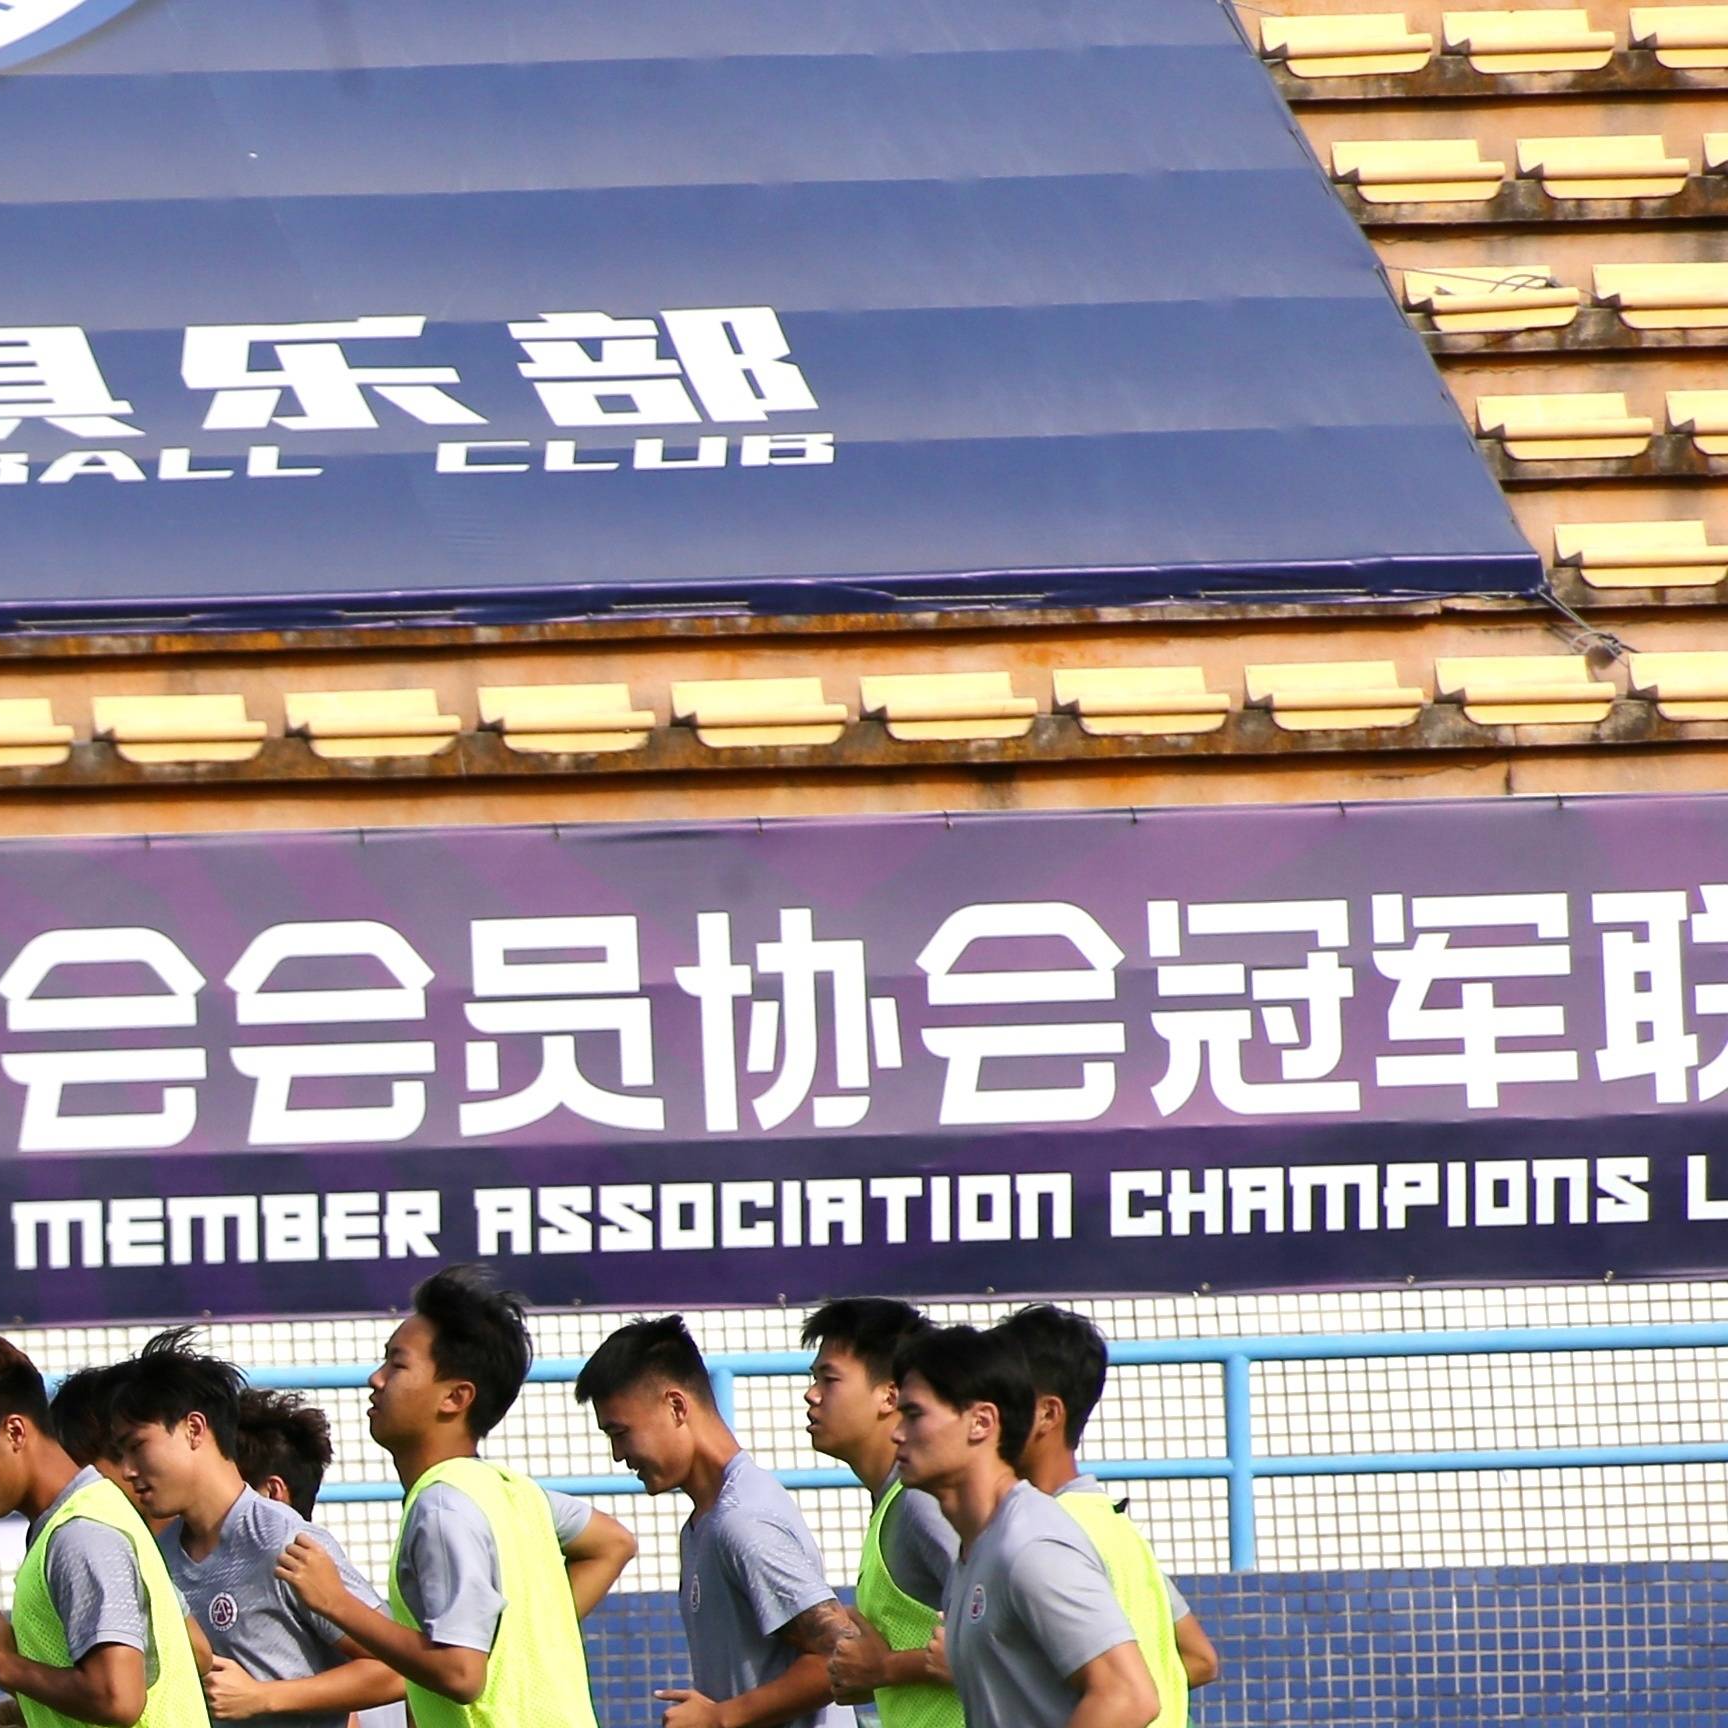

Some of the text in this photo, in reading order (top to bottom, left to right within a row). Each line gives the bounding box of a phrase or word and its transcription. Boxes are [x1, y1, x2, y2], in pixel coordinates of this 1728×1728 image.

[435, 432, 836, 475] CLUB
[12, 1190, 440, 1268] MEMBER
[474, 1172, 1072, 1256] ASSOCIATION
[1110, 1156, 1650, 1237] CHAMPIONS
